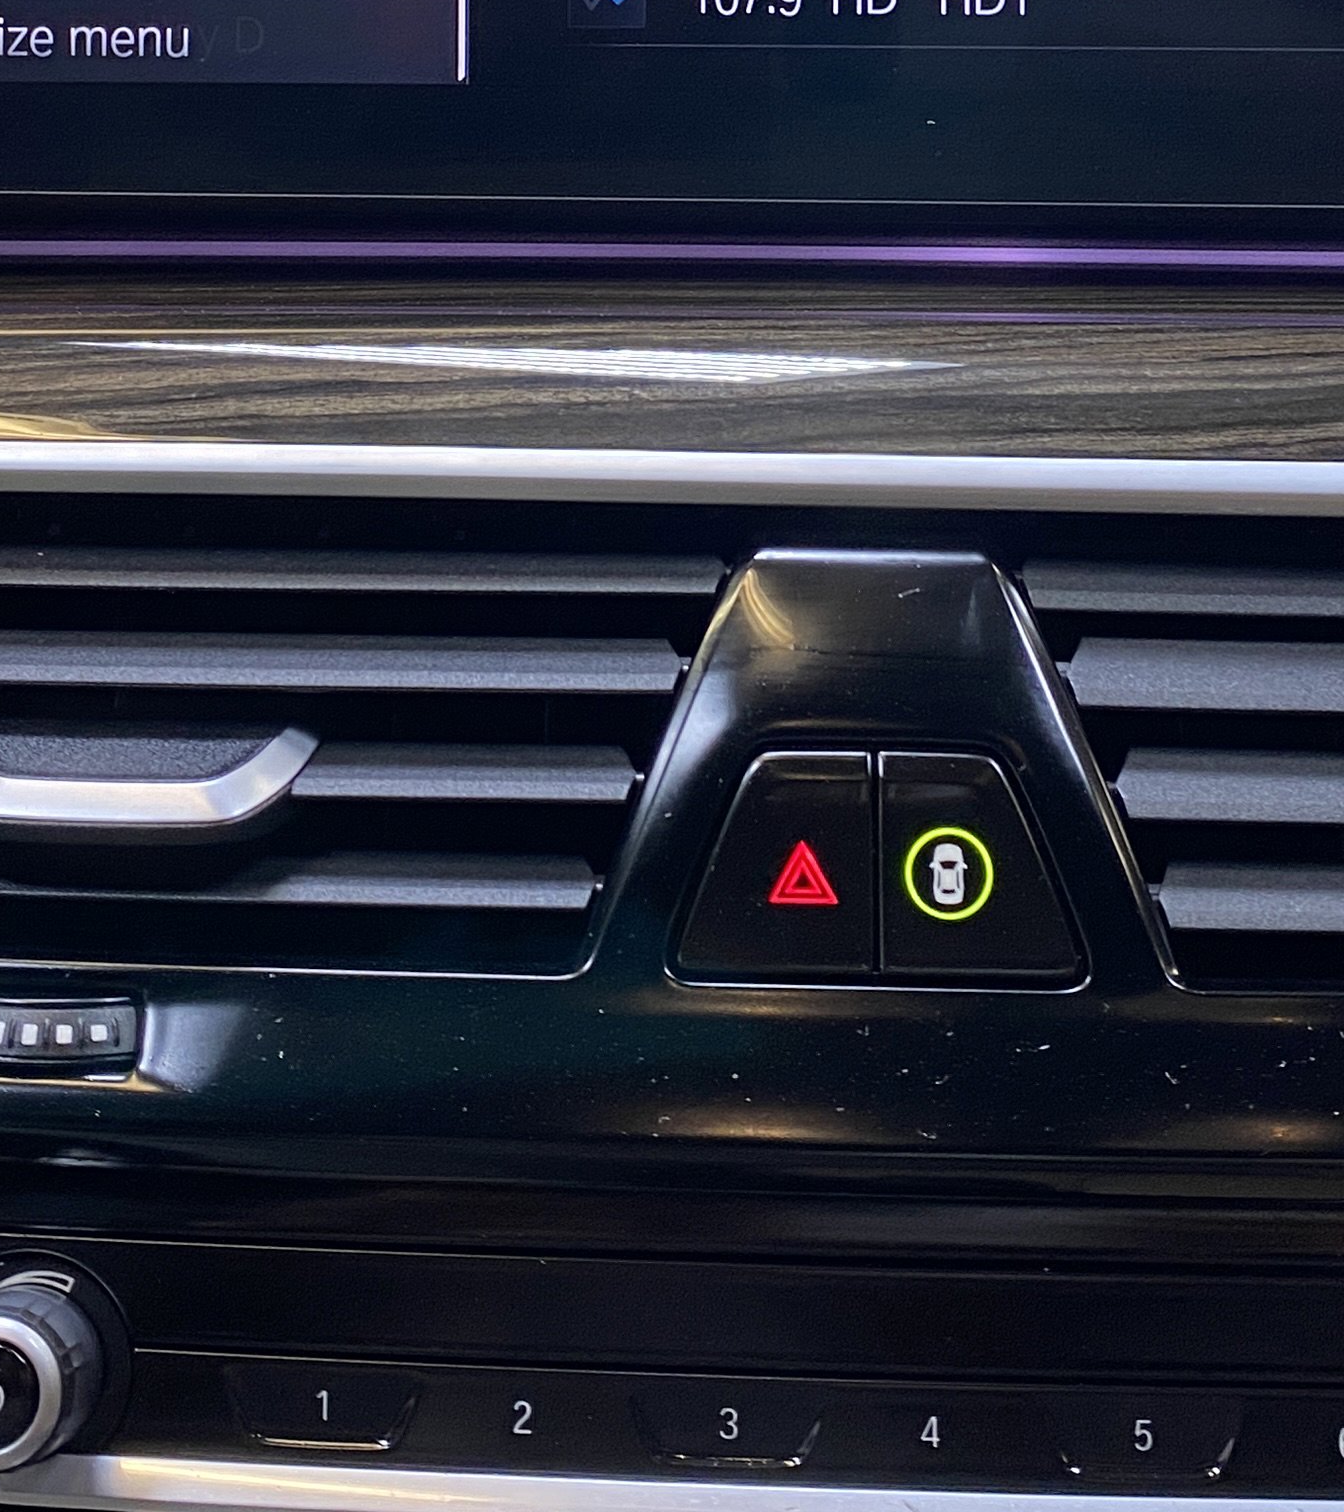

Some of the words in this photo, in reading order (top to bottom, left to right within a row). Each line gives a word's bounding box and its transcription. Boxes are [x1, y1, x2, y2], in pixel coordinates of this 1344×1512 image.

[70, 26, 189, 58] menu
[316, 1390, 328, 1421] 1
[512, 1400, 533, 1435] 2
[719, 1407, 739, 1440] 3
[920, 1415, 941, 1448] 4
[1134, 1419, 1153, 1452] 5
